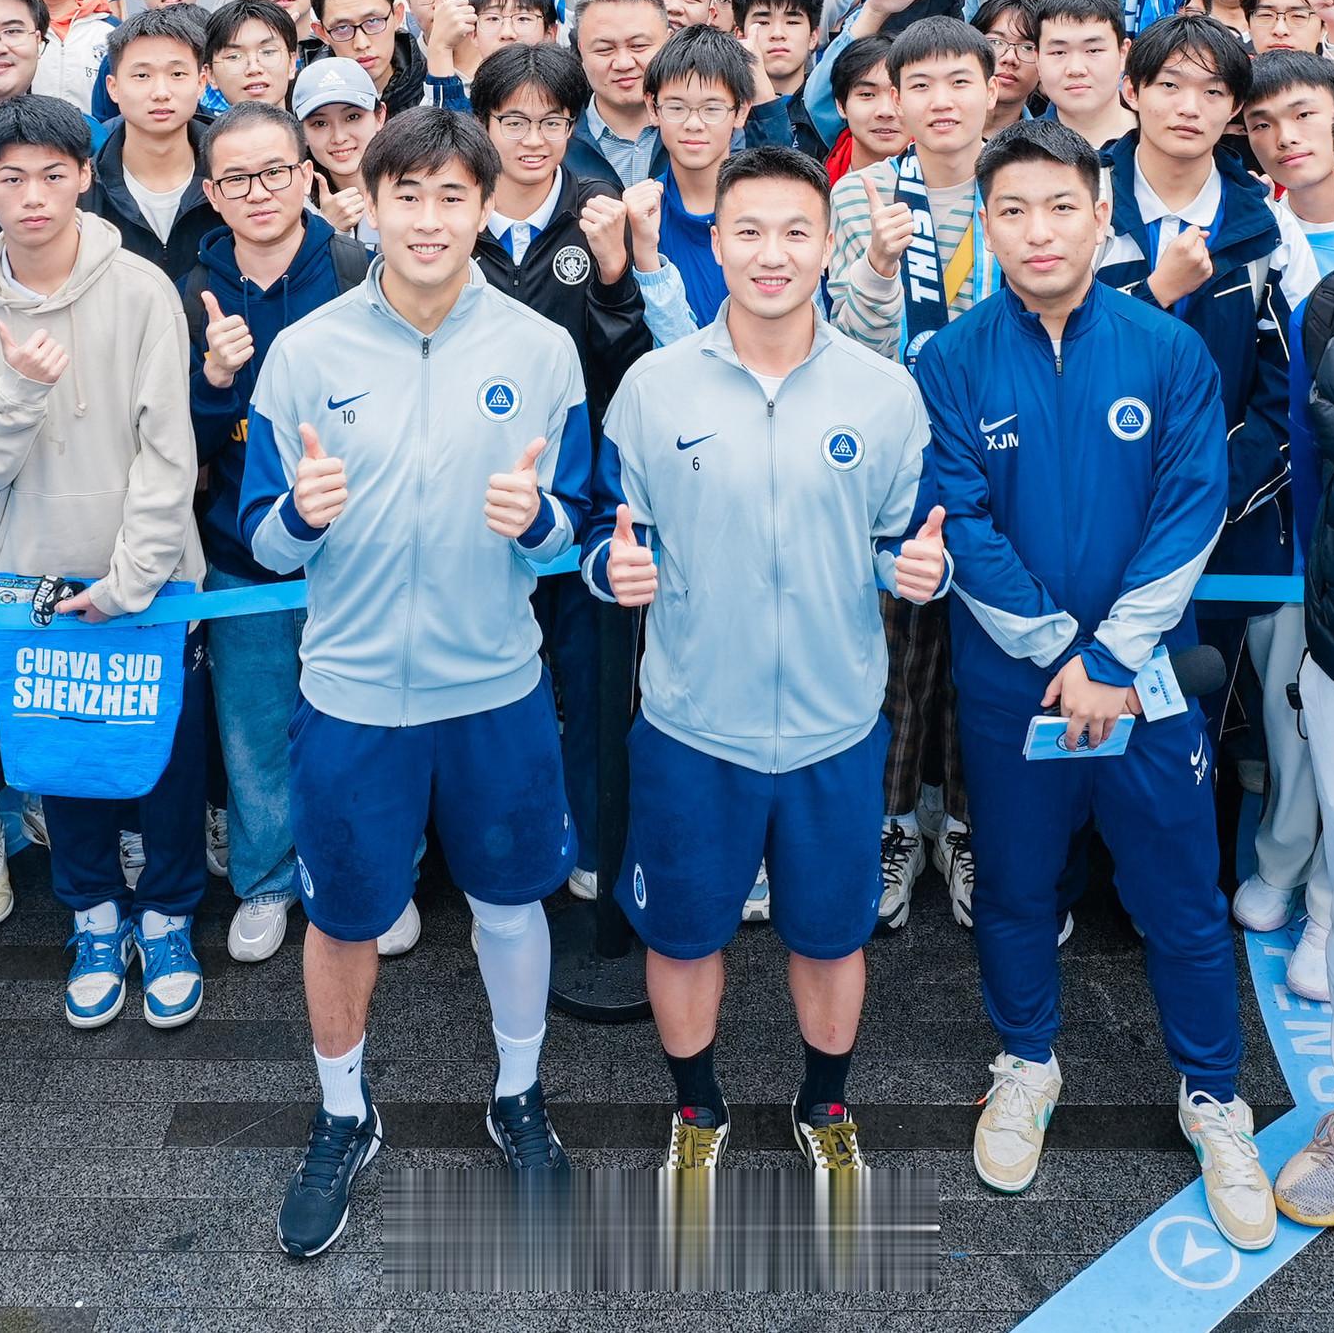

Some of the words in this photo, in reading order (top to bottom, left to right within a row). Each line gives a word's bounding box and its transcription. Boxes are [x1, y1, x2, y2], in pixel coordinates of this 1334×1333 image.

[908, 208, 940, 305] THIS
[341, 409, 356, 425] 10
[691, 457, 701, 472] 6
[16, 647, 102, 682] CURVA
[107, 653, 163, 682] SUD
[12, 676, 160, 716] SHENZHEN
